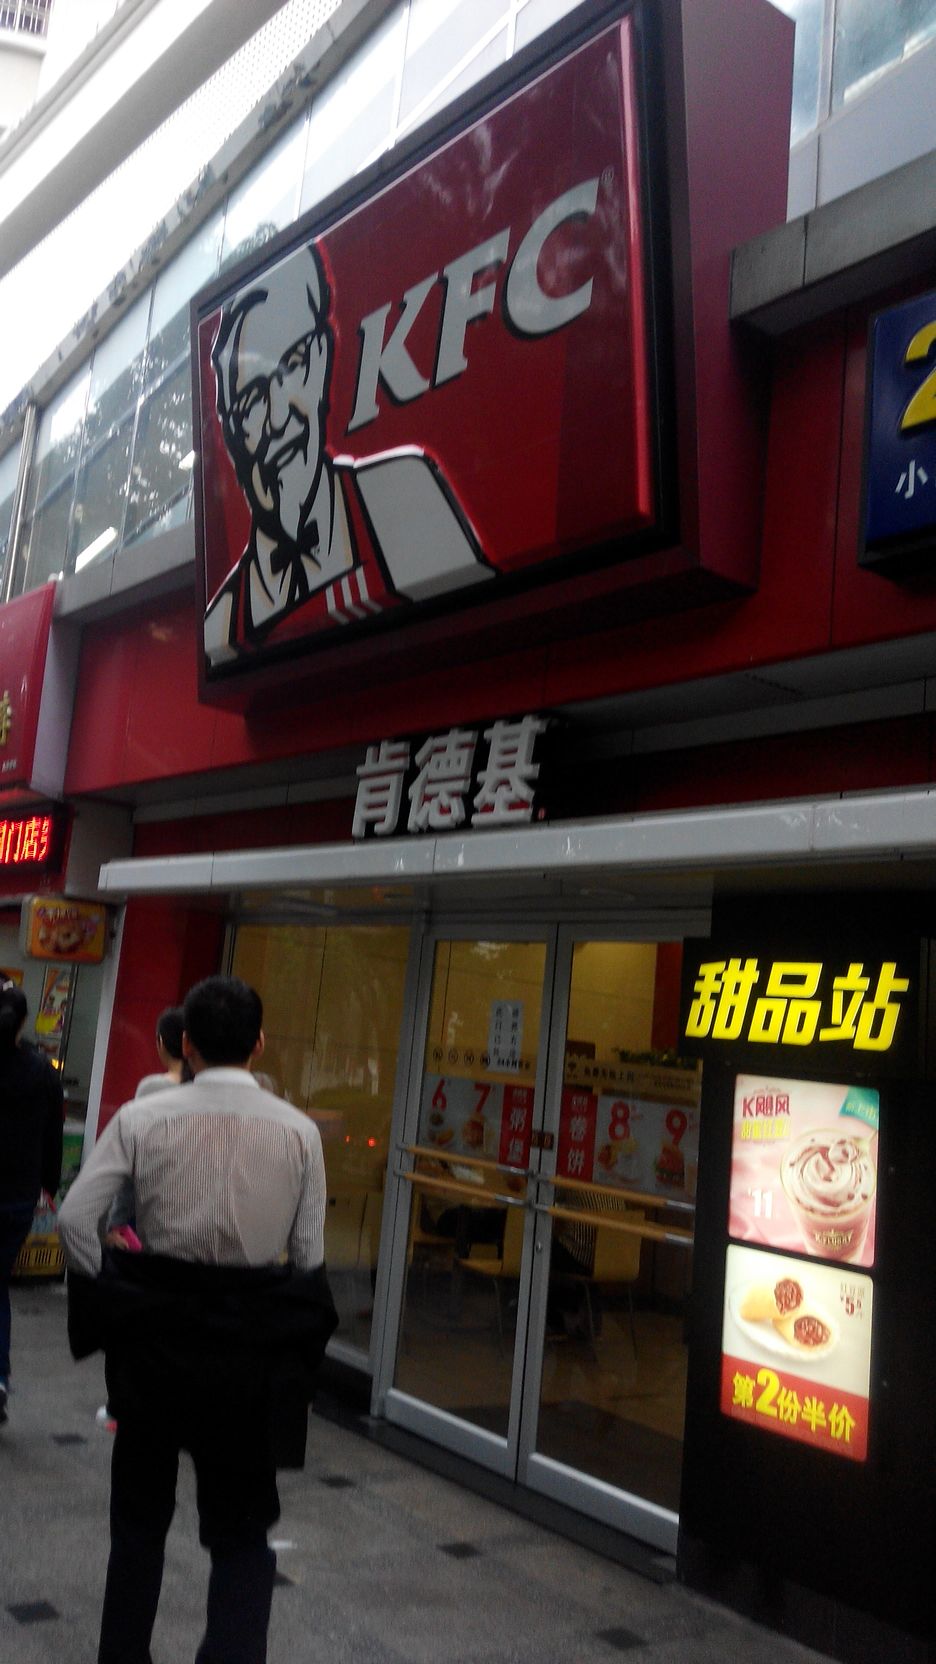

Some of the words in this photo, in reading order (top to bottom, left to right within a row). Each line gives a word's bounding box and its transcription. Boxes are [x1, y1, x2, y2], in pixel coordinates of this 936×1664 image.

[346, 177, 600, 435] KFC
[351, 714, 549, 840] 肯德基
[685, 957, 909, 1050] 甜品站
[608, 1100, 630, 1142] 8
[665, 1108, 688, 1146] 9
[732, 1368, 855, 1442] 第2份半价
